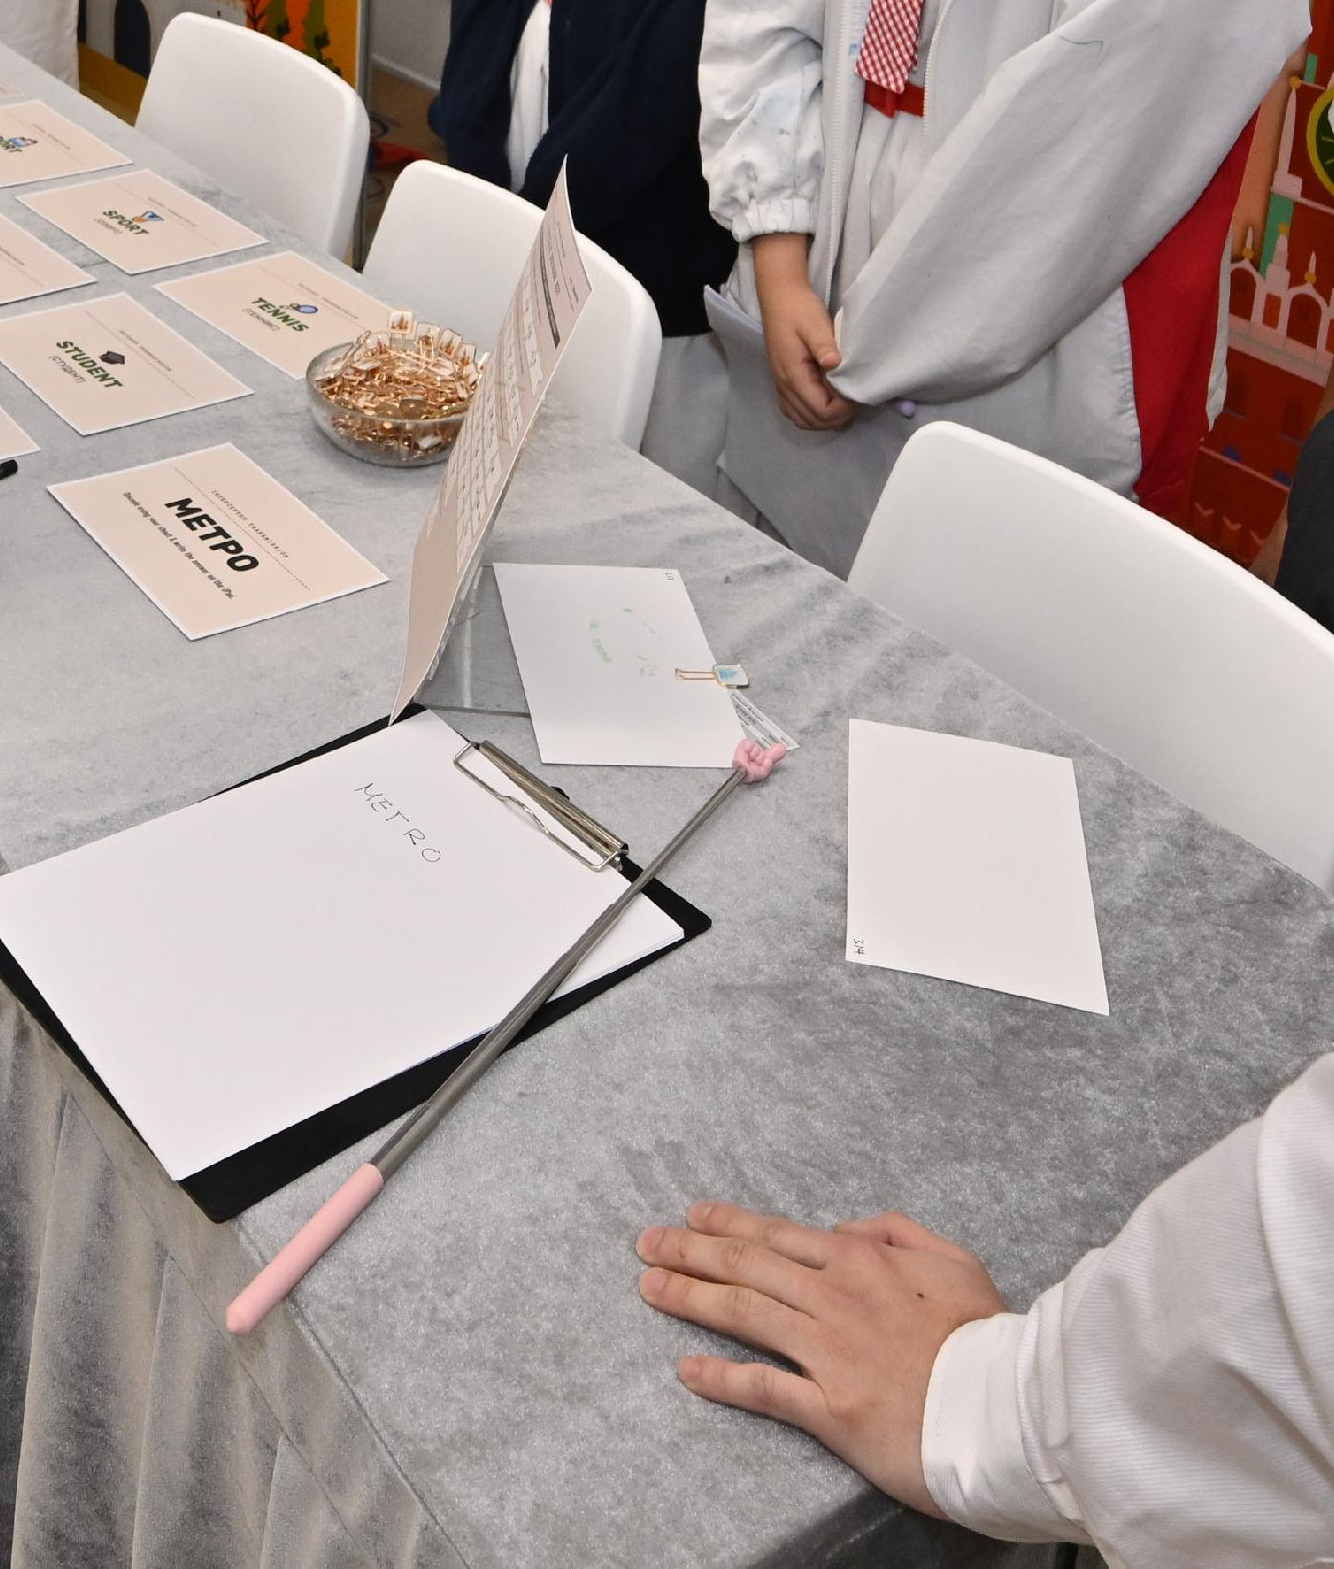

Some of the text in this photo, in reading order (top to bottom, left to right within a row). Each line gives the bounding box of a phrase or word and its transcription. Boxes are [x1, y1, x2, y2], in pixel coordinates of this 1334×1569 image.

[102, 210, 150, 235] SPORT
[251, 297, 310, 332] TENNIS
[55, 340, 124, 388] STUDENT
[164, 497, 260, 572] МЕТРО
[354, 782, 442, 863] METRO
